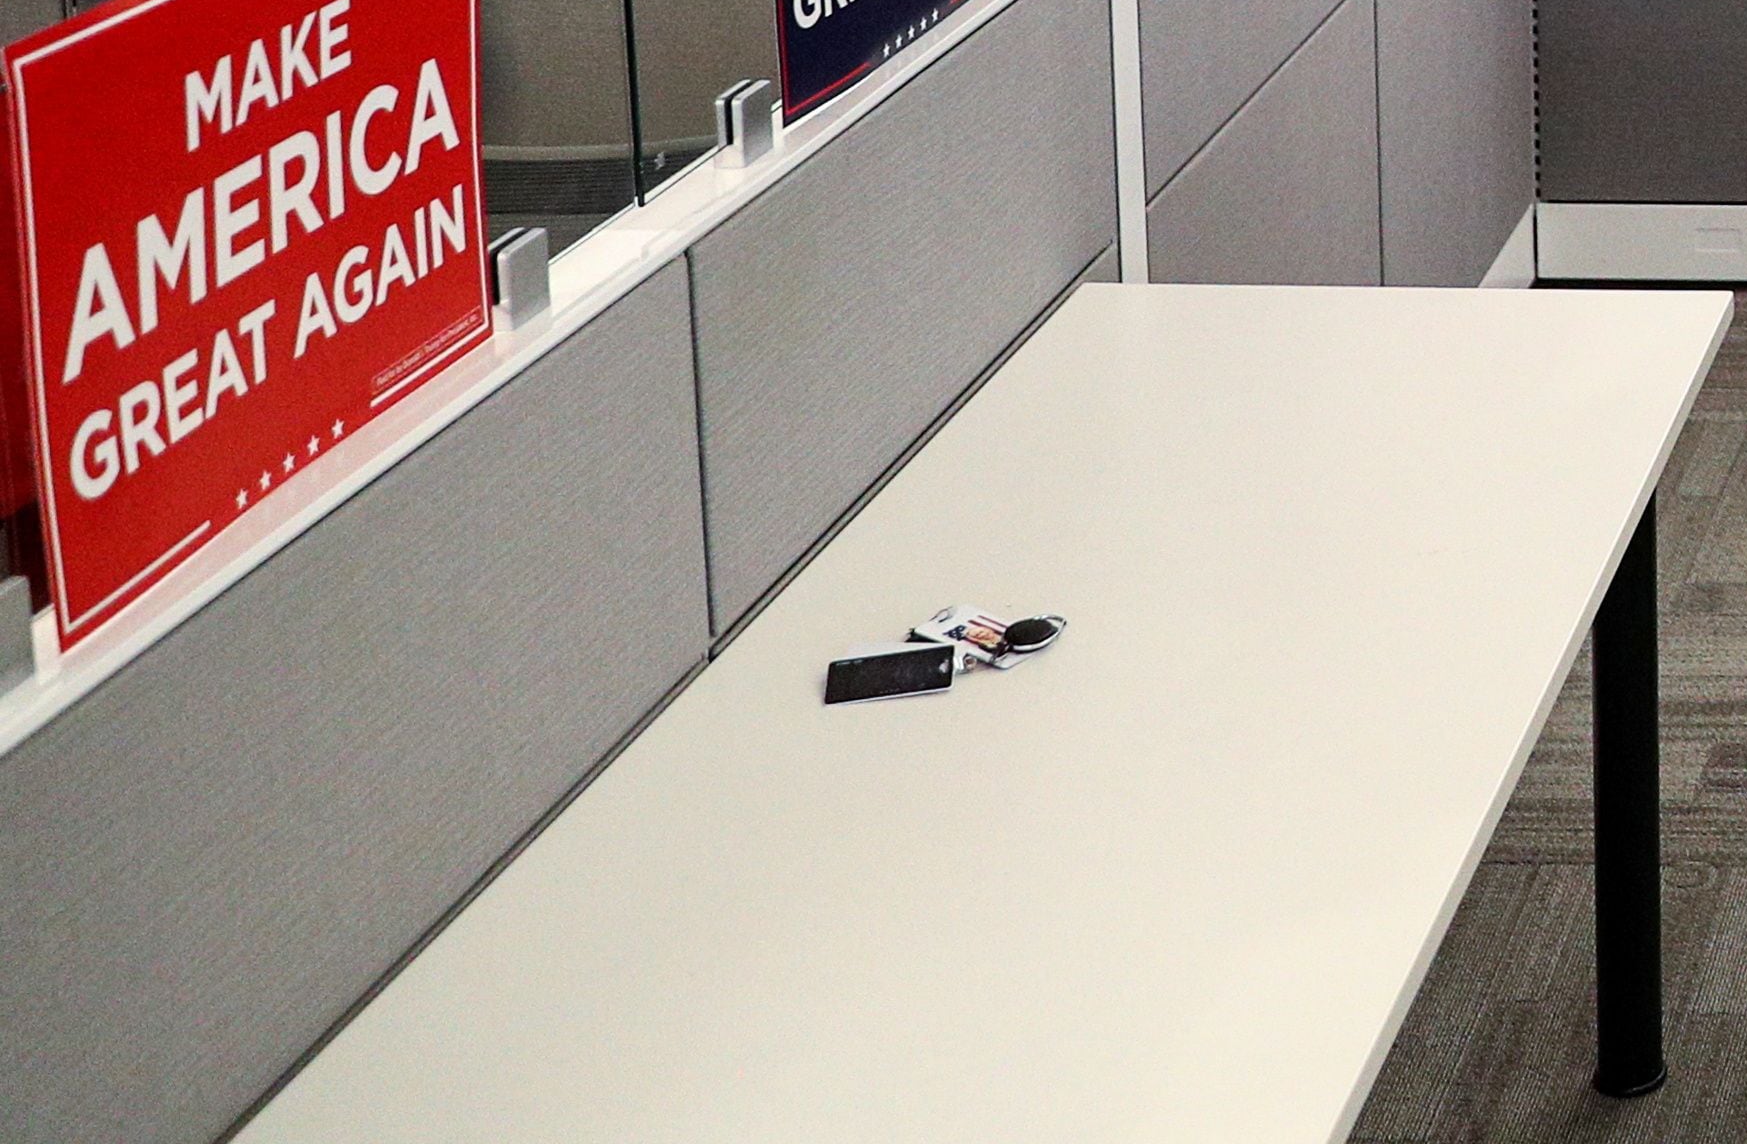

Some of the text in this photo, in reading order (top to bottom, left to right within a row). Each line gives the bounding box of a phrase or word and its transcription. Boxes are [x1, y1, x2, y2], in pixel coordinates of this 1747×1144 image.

[62, 57, 460, 385] AMERICA
[69, 183, 467, 502] GREAT AGAIN
